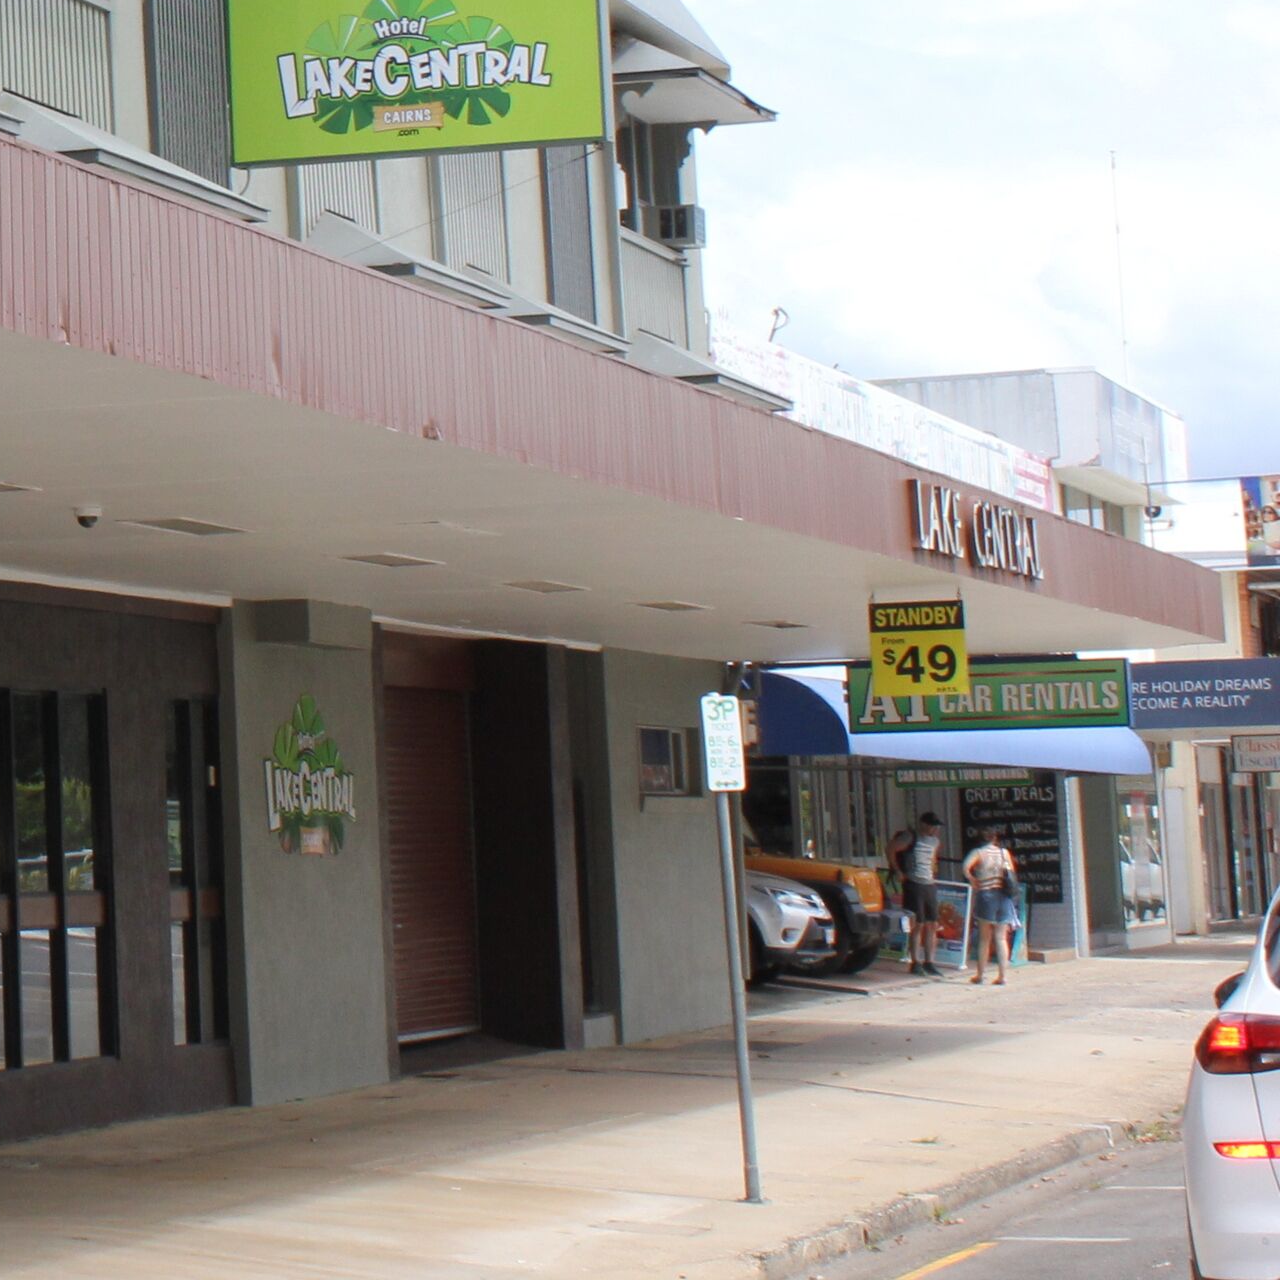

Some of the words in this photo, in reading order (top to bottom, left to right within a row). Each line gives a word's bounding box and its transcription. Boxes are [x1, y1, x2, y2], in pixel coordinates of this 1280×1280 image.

[373, 17, 427, 40] Hotel
[383, 109, 432, 124] CAIRNS
[397, 128, 420, 137] .com
[909, 479, 964, 559] LAKE
[970, 498, 1044, 579] CENTRAL
[874, 606, 959, 628] STANDBY
[882, 644, 957, 683] $49
[1152, 680, 1211, 693] HOLIDAY
[1215, 678, 1272, 691] DREAMS
[940, 685, 992, 713] CAR
[1002, 681, 1120, 712] RENTALS
[1182, 697, 1193, 708] A
[706, 700, 735, 720] 3P
[965, 787, 1007, 803] GREAT
[1012, 786, 1055, 801] DEALS
